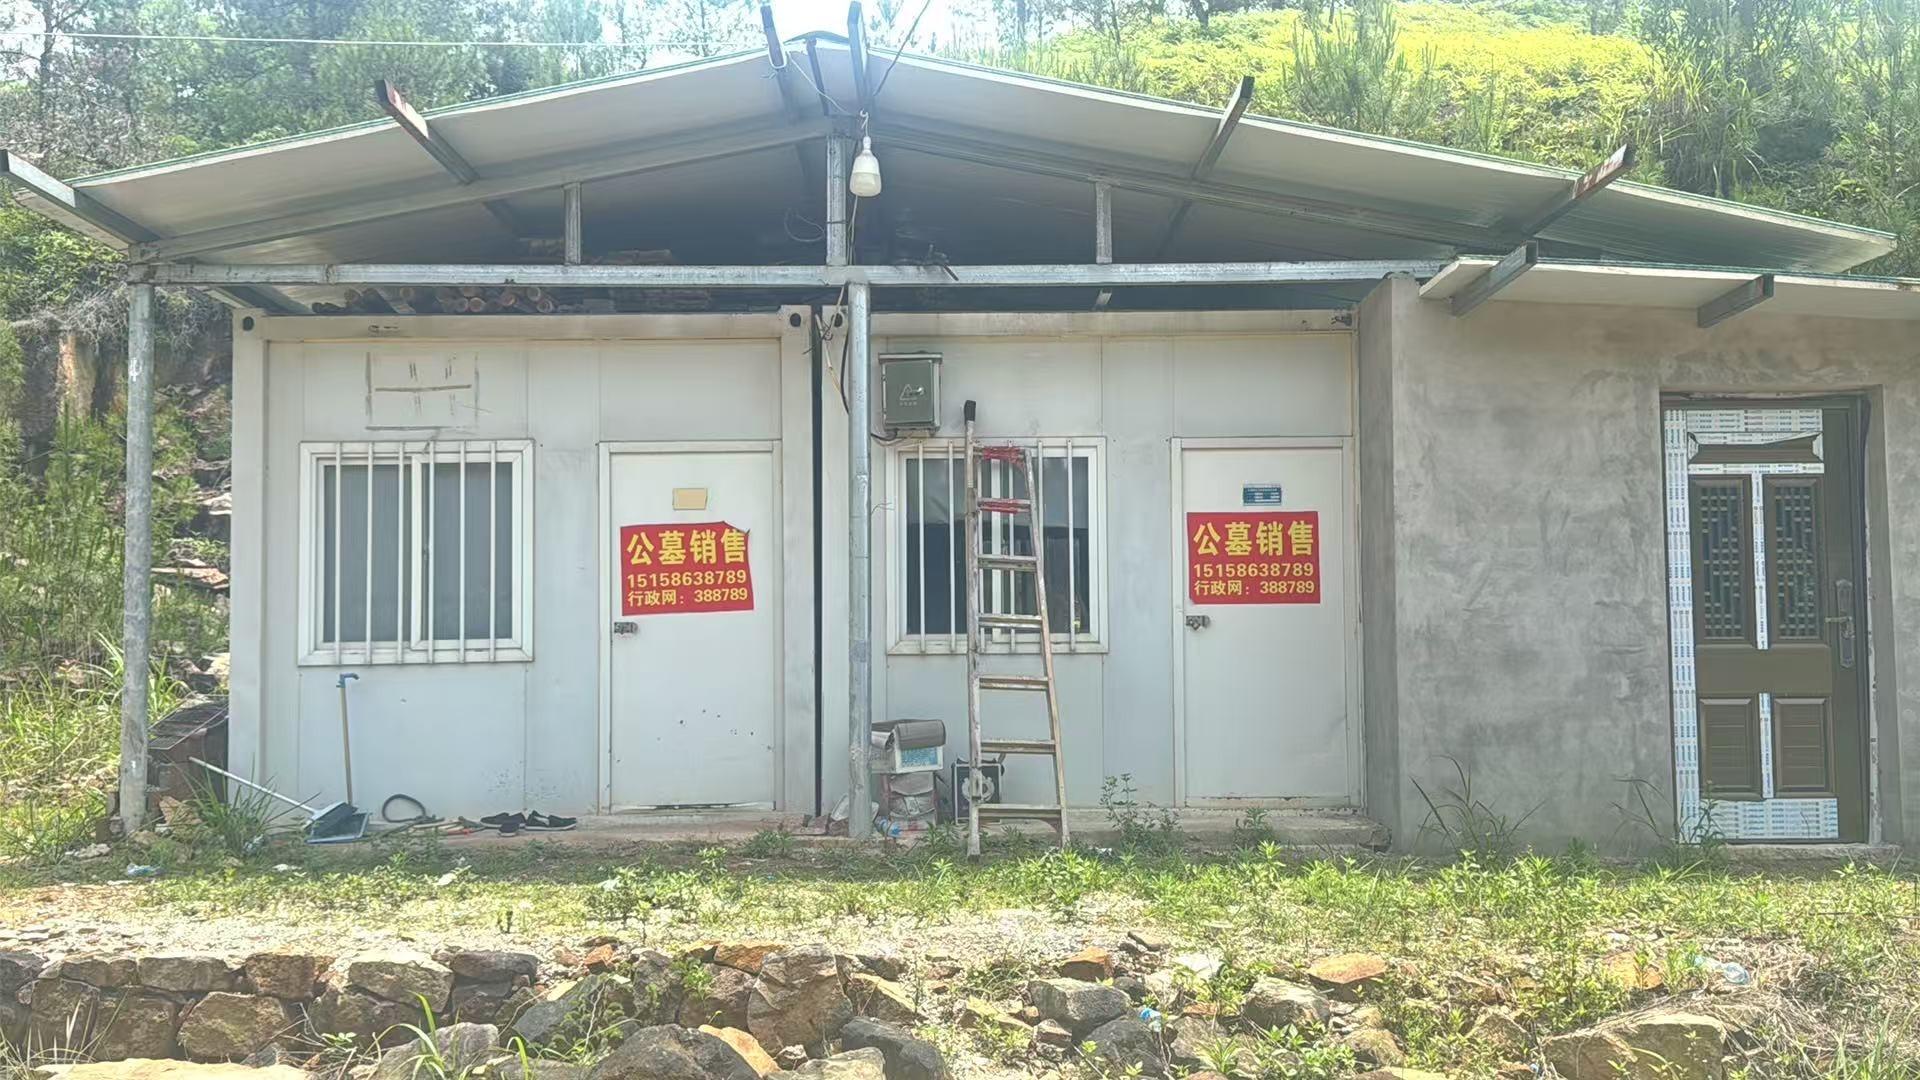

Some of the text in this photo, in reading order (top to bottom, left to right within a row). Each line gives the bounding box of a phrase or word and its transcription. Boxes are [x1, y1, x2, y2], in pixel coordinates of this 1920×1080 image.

[627, 528, 747, 566] 公墓销售
[1193, 520, 1314, 556] 公墓销售
[627, 569, 747, 588] 15158638789
[1193, 562, 1314, 578] 15158638789
